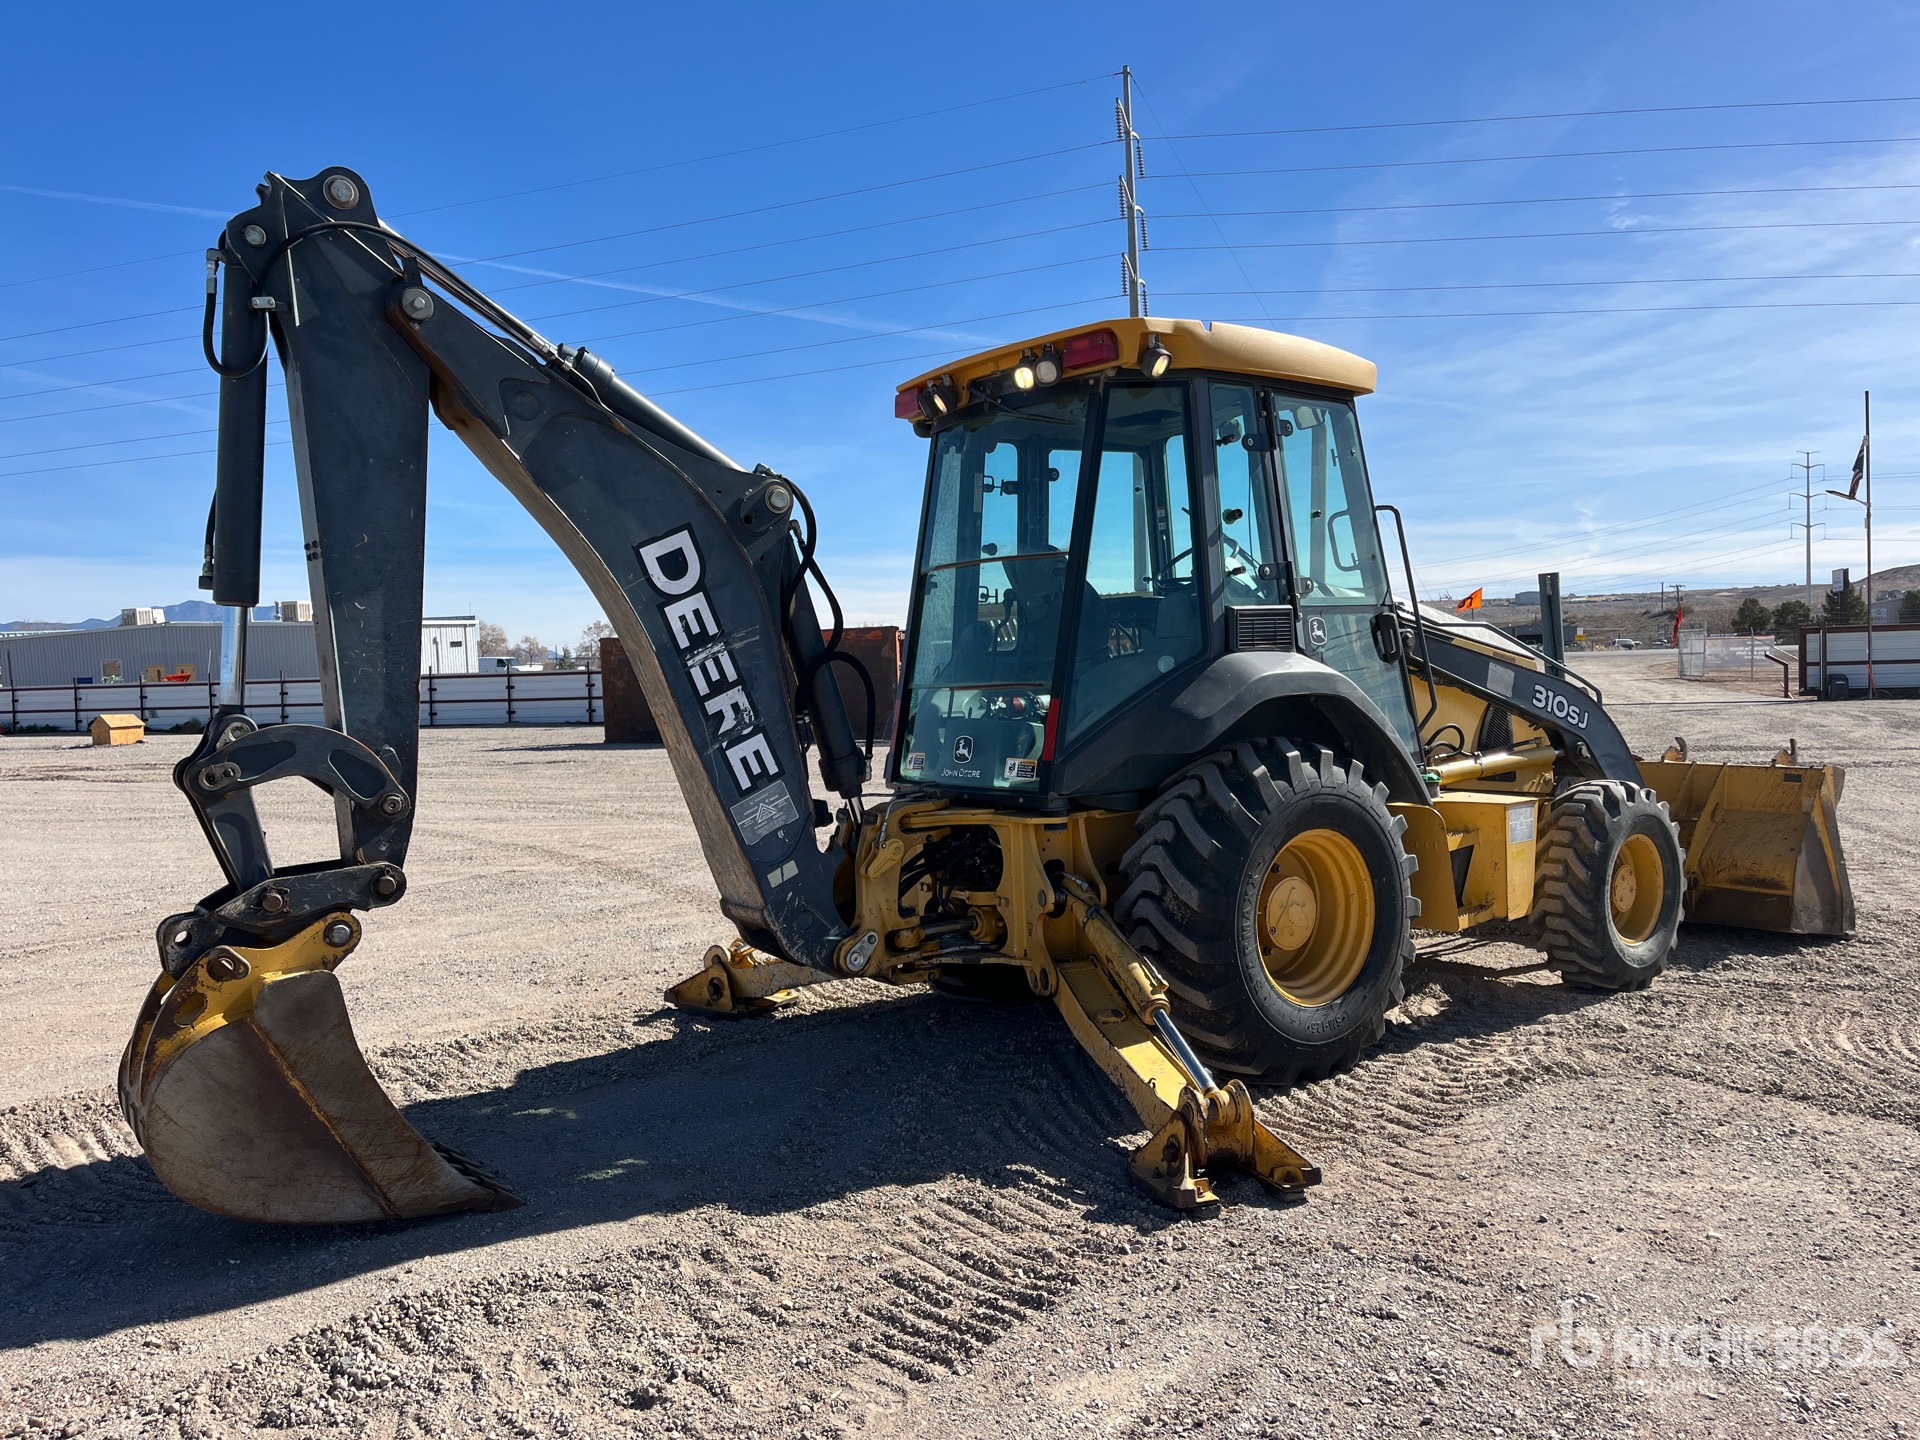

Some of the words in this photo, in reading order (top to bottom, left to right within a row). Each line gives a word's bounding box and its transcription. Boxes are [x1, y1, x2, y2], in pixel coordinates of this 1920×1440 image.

[639, 529, 780, 791] DEERE
[1532, 684, 1589, 729] 310SJ
[941, 768, 958, 777] JOHN
[959, 768, 981, 778] DEERE
